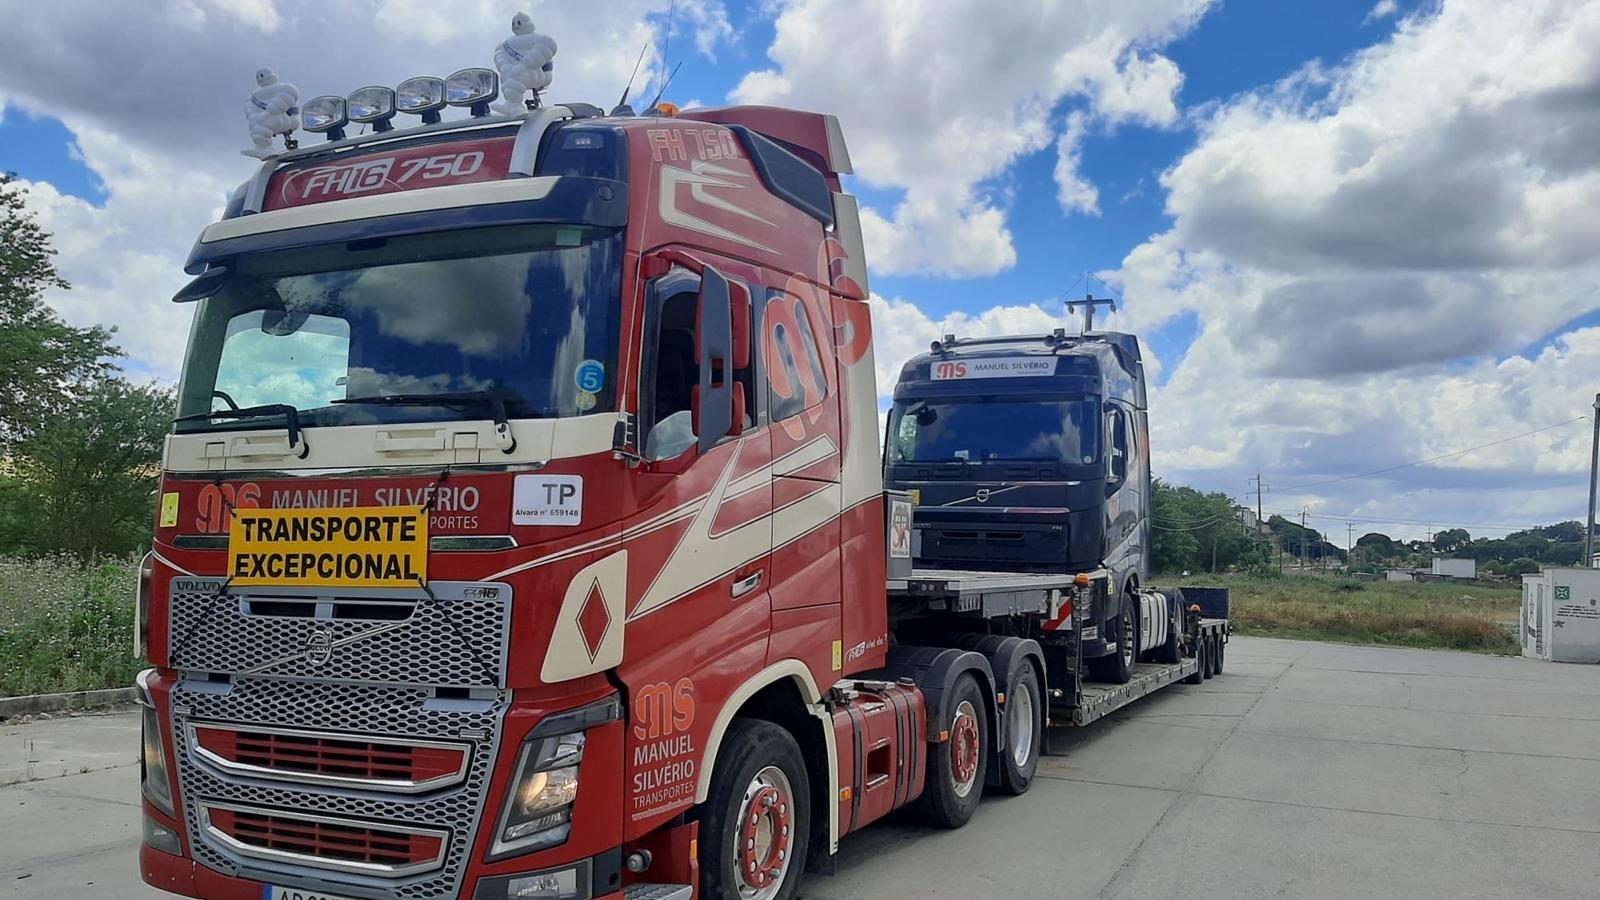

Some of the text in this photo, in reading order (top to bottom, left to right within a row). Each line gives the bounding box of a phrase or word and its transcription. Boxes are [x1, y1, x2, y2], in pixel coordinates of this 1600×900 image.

[647, 128, 738, 161] FH 750
[396, 150, 485, 184] 750
[582, 371, 598, 389] 5
[974, 362, 1009, 372] MANUEL
[542, 483, 576, 505] TP
[241, 516, 417, 542] TRANSPORTE
[430, 515, 478, 529] PORTES
[235, 553, 419, 580] EXCEPCIONAL
[176, 581, 221, 591] VOLVO
[633, 734, 694, 767] MANUEL
[633, 759, 695, 793] SILVÉRIO
[632, 780, 695, 809] TRANSPORTES
